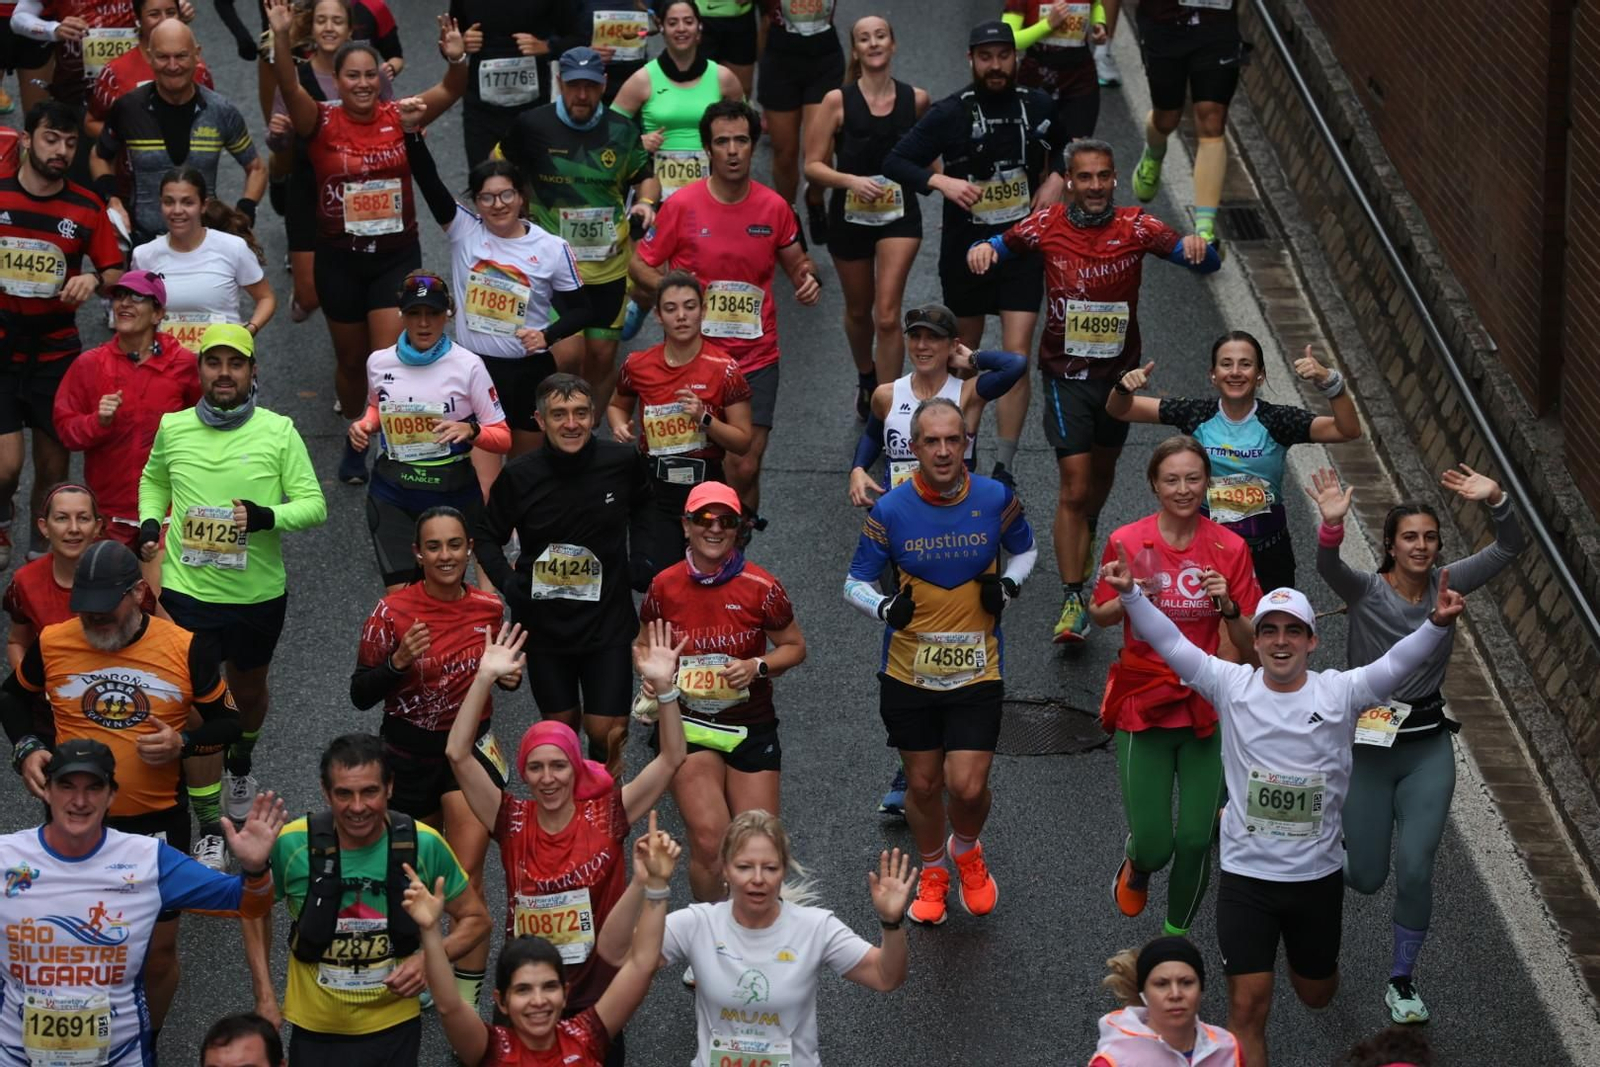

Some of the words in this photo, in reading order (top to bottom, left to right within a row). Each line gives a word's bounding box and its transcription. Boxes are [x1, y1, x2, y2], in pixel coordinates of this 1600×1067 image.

[484, 70, 528, 87] 17776
[660, 162, 701, 179] 10768
[570, 221, 605, 239] 7357
[4, 252, 56, 274] 14452
[470, 288, 517, 313] 11881
[709, 294, 754, 314] 13845
[1071, 315, 1119, 334] 14899
[648, 417, 697, 438] 13684
[1229, 447, 1263, 459] POWER
[1216, 487, 1265, 505] 13959
[187, 520, 238, 544] 14125
[904, 531, 988, 555] agustinos
[923, 646, 975, 667] 14586
[95, 681, 135, 695] BEER
[1258, 787, 1306, 811] 6691
[519, 909, 580, 935] 10872
[30, 1013, 96, 1038] 12691
[719, 1007, 780, 1027] MUM
